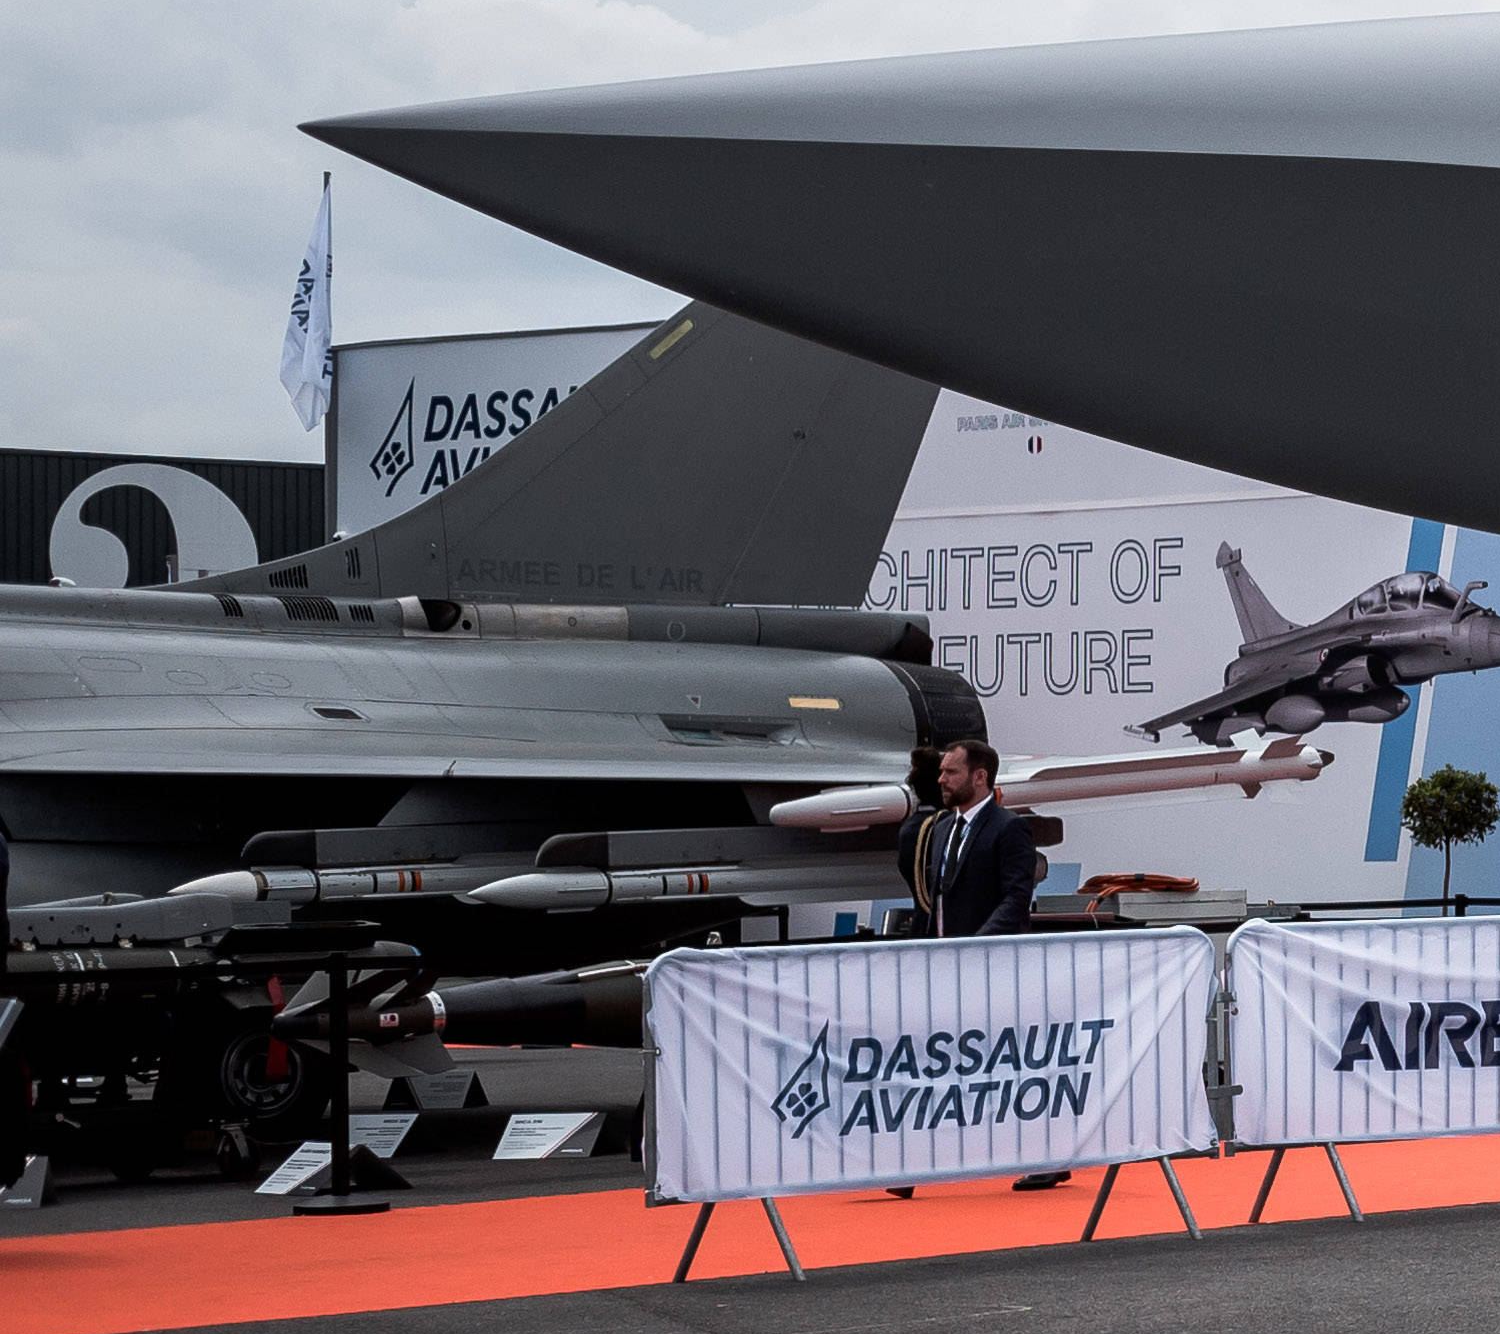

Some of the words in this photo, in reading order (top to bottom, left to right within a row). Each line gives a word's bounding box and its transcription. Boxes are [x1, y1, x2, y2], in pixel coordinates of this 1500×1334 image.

[423, 385, 578, 443] DASSA
[459, 557, 561, 587] ARMEE
[576, 562, 616, 590] DE
[1110, 537, 1184, 604] OF
[936, 628, 1153, 697] FUTURE
[843, 1018, 1114, 1083] DASSAULT
[839, 1071, 1092, 1137] AVIATION
